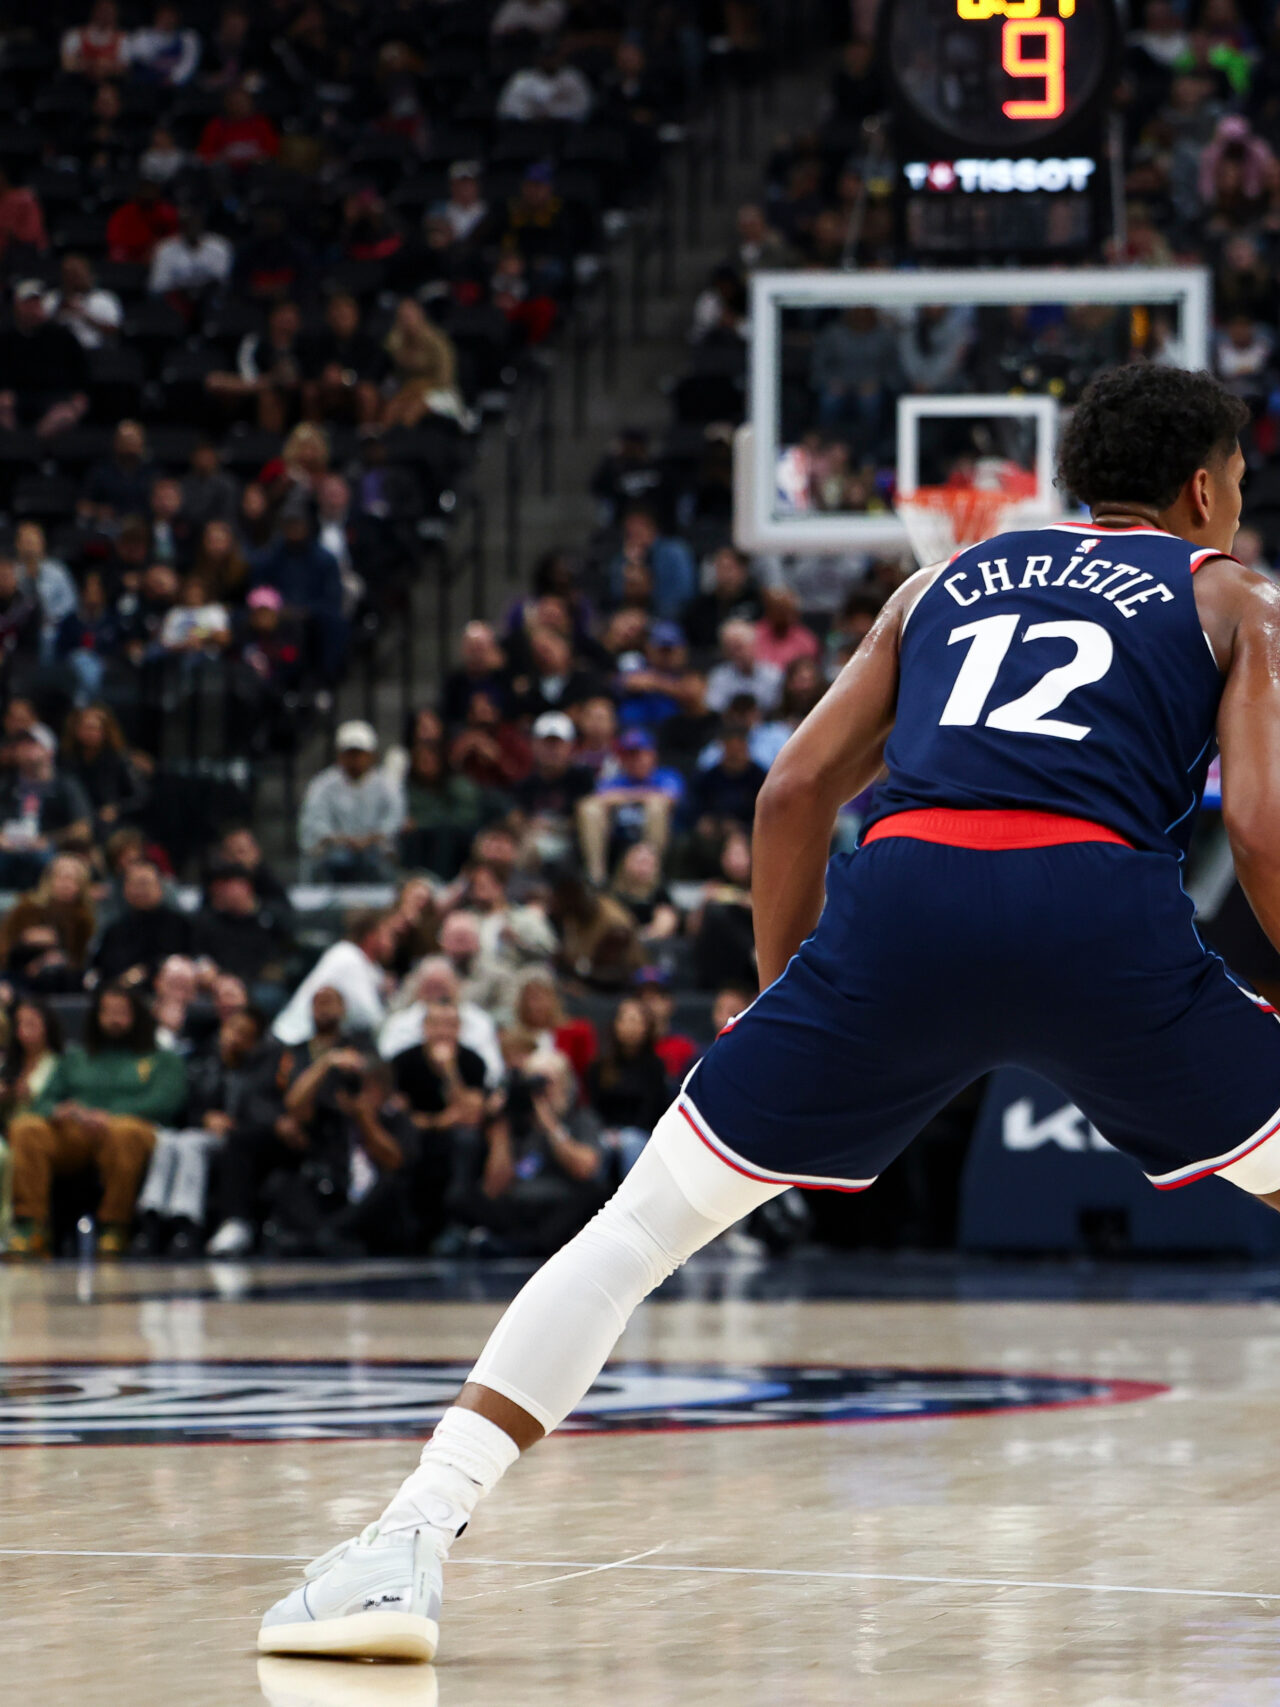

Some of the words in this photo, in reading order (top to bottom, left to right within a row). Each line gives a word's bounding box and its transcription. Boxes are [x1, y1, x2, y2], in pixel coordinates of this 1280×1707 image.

[1002, 17, 1065, 120] 9
[955, 157, 1095, 193] TISSOT
[943, 555, 1175, 619] CHRISTIE
[939, 614, 1114, 741] 12
